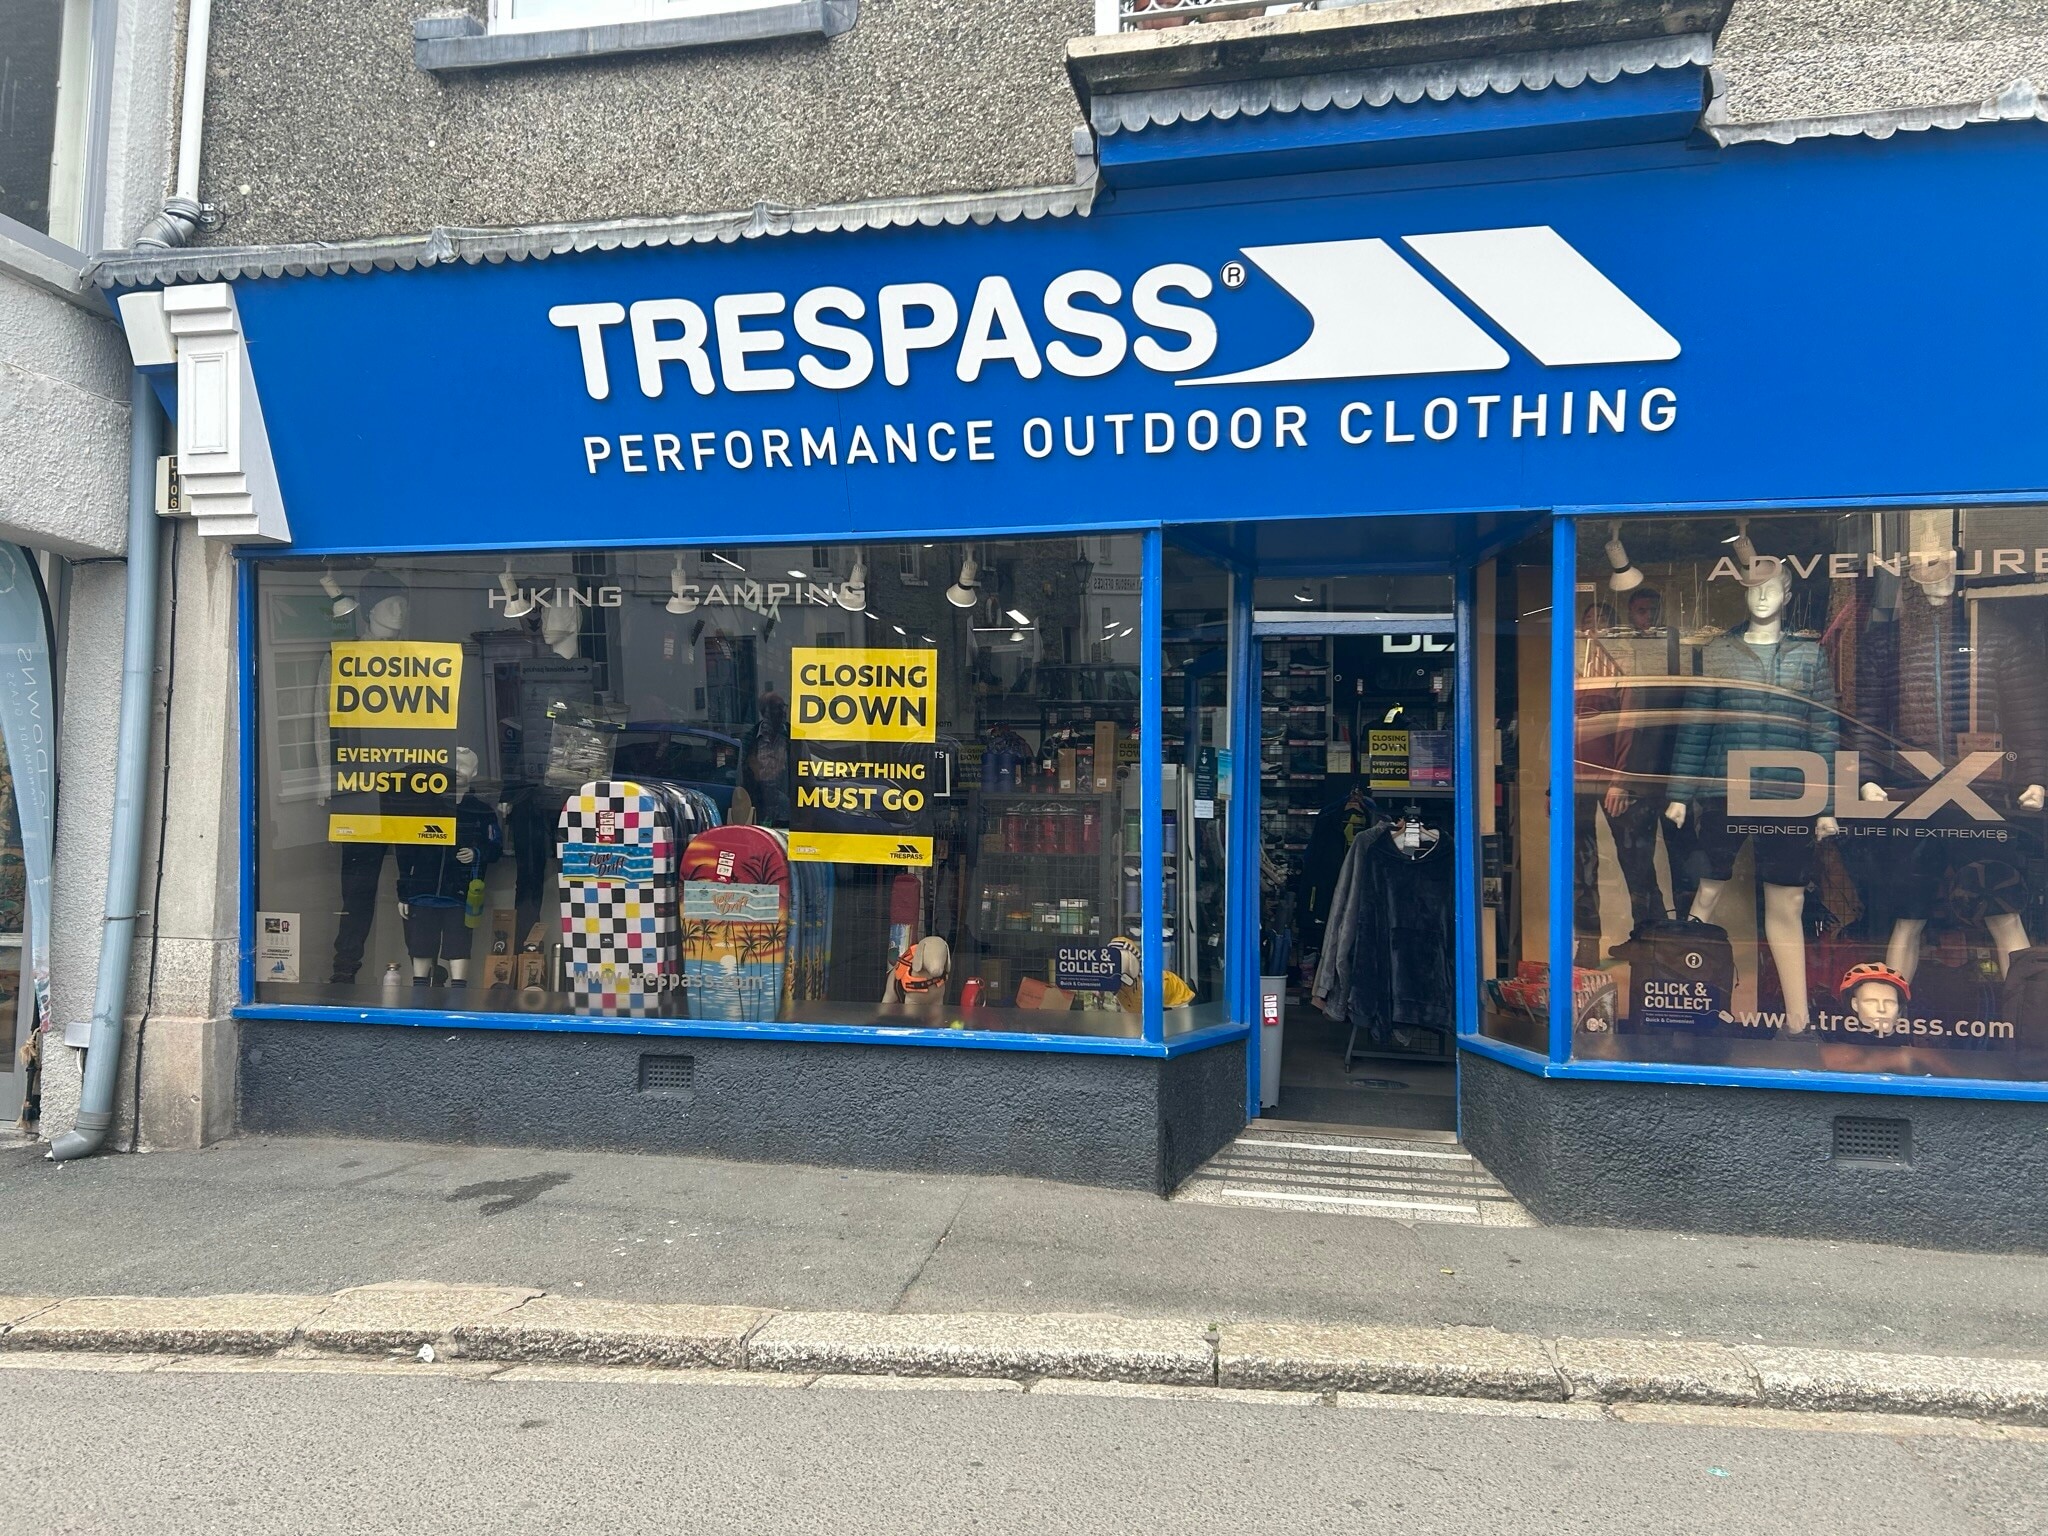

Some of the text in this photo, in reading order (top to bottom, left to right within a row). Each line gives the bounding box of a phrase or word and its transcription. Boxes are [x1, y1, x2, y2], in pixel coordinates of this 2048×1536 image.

[547, 262, 1218, 400] TRESPASS
[582, 386, 1678, 474] PERFORMANCE OUTDOOR CLOTHING
[488, 581, 866, 609] HIKING CAMPING
[1382, 634, 1455, 653] DL
[338, 656, 452, 679] CLOSING
[800, 664, 927, 688] CLOSING
[336, 685, 450, 714] DOWN
[799, 694, 927, 727] DOWN
[337, 747, 449, 764] EVERYTHING
[1372, 742, 1407, 751] DOWN
[797, 760, 926, 780] EVERYTHING
[337, 771, 448, 794] MUST GO
[1726, 749, 2007, 821] DLX
[797, 786, 925, 812] MUST GO
[417, 832, 448, 840] TRESPASS
[1726, 824, 1809, 835] DESIGNED
[1854, 826, 1889, 837] LIFE
[1892, 827, 1909, 838] IN
[1915, 828, 2009, 839] EXTREMES
[889, 852, 924, 860] TRESPASS
[1059, 948, 1112, 962] CLICK &
[1059, 961, 1116, 974] COLLECT
[1644, 981, 1707, 997] CLICK &
[1644, 995, 1713, 1011] COLLECT
[1666, 1017, 1695, 1025] Convenient
